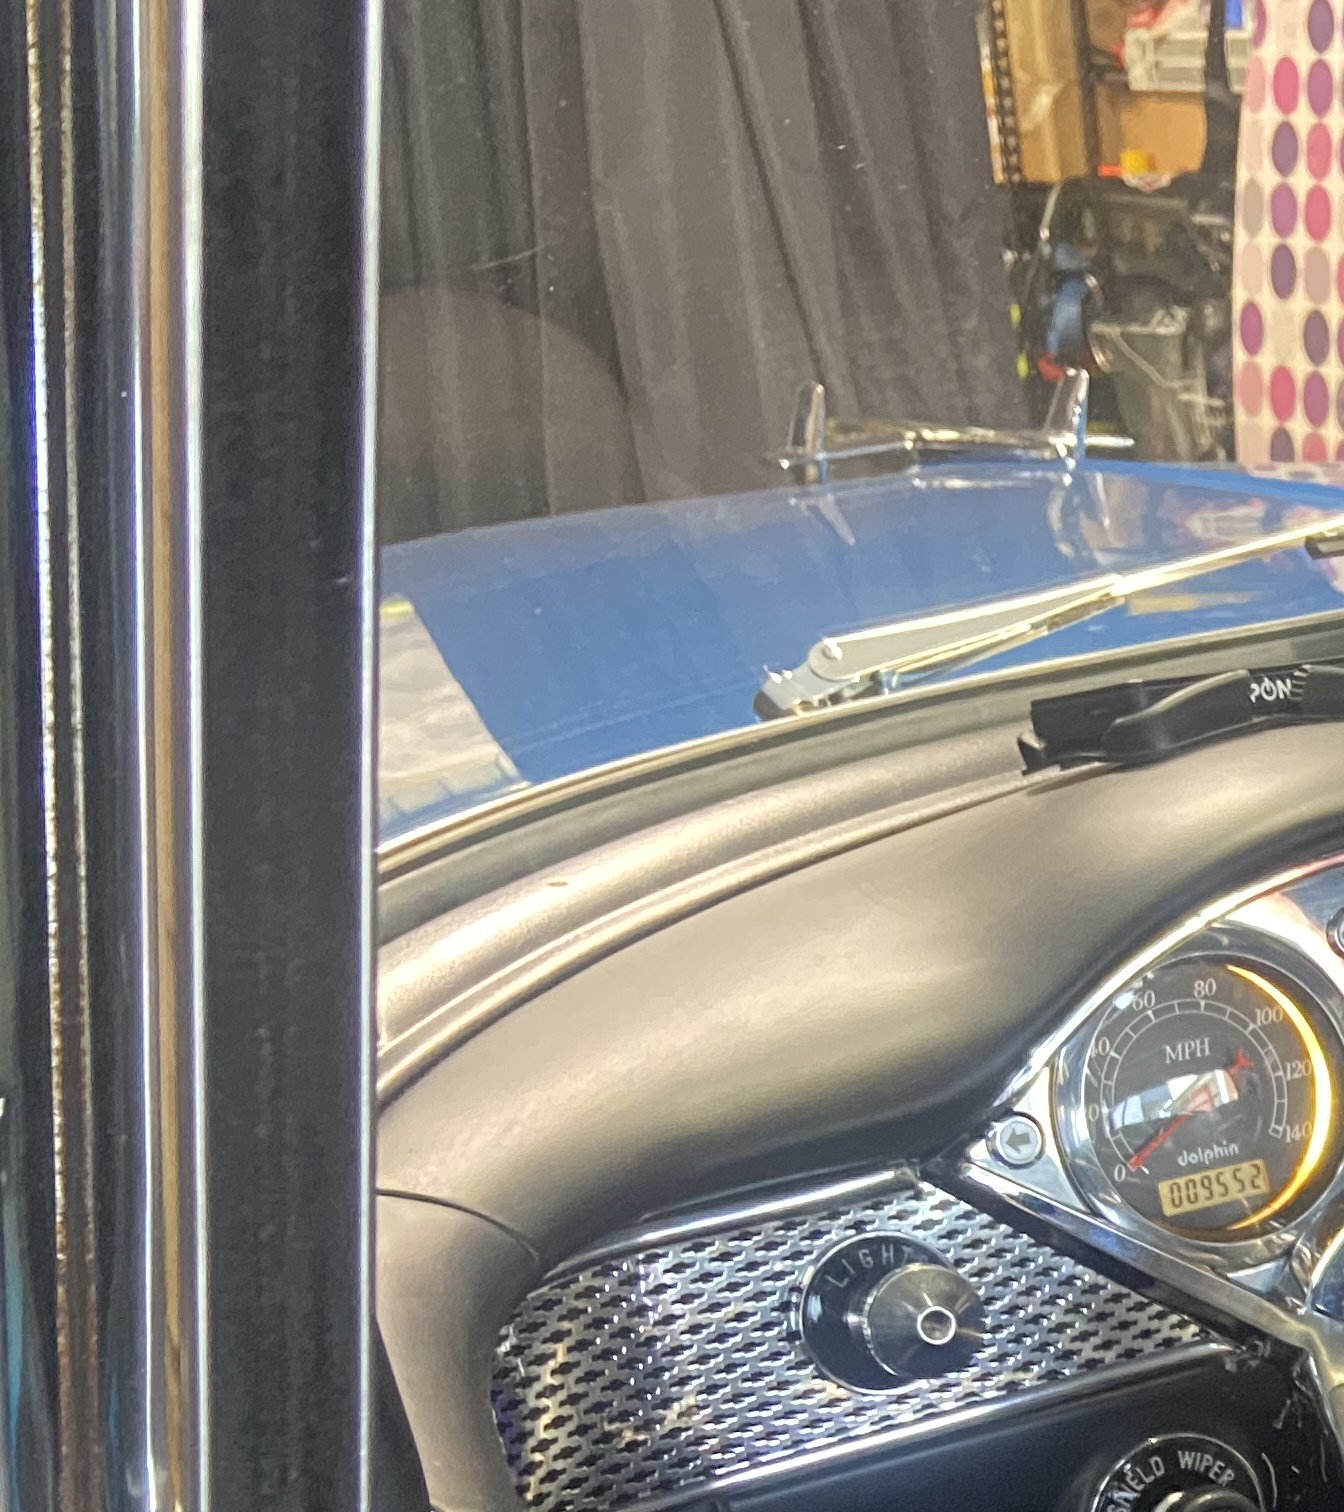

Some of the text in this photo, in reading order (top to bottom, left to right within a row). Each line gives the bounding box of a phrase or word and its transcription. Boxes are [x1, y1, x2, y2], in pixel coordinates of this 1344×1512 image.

[1193, 978, 1217, 998] 80
[1132, 990, 1156, 1011] 60
[1255, 1006, 1283, 1026] 100
[1164, 1037, 1211, 1064] MPH
[1285, 1060, 1312, 1081] 120
[1285, 1122, 1314, 1143] 140
[1177, 1140, 1240, 1167] dolphin
[1113, 1165, 1126, 1182] 0
[1169, 1162, 1263, 1209] 009552
[1177, 1450, 1235, 1487] WIPER
